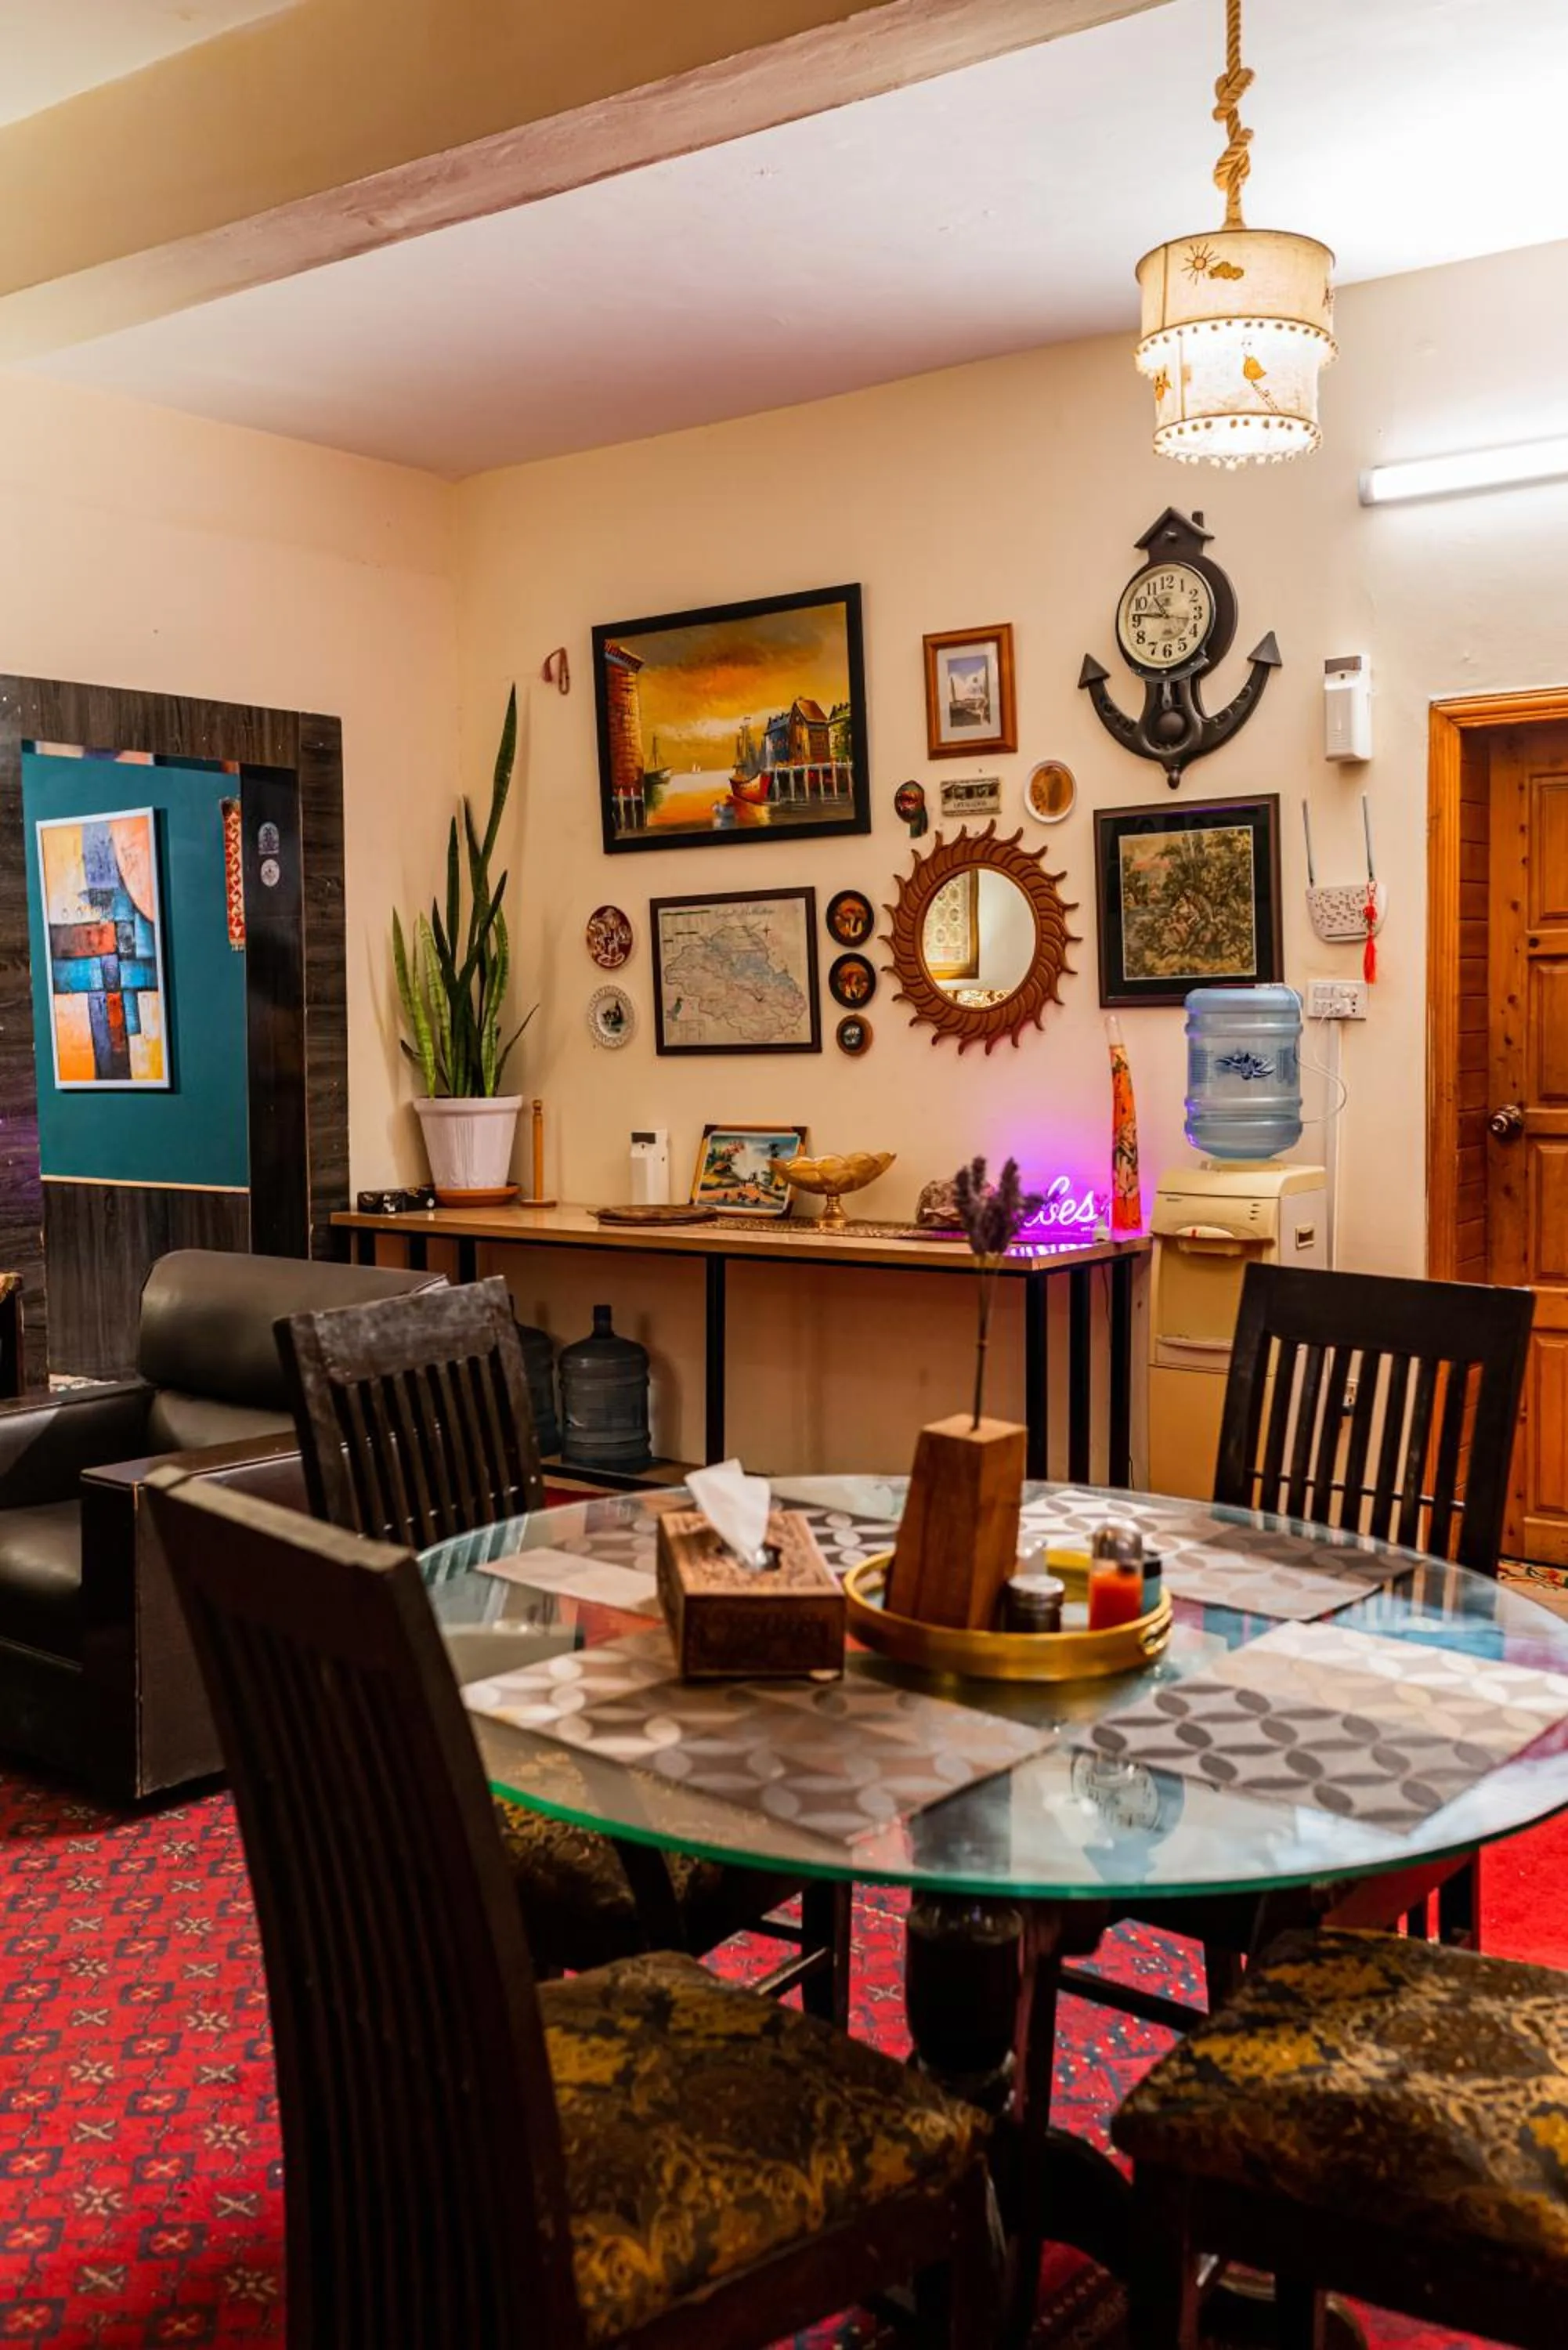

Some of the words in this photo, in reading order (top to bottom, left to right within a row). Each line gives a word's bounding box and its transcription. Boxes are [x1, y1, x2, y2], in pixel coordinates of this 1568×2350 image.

[1147, 582, 1158, 595] 11
[1160, 574, 1175, 589] 12
[1180, 579, 1185, 592] 1
[1189, 589, 1198, 602] 2
[1135, 597, 1147, 611] 10
[1132, 613, 1142, 627] 9
[1193, 606, 1202, 620] 3
[1136, 631, 1146, 645] 8
[1189, 624, 1198, 638] 4
[1147, 642, 1158, 656] 7
[1162, 643, 1172, 658] 6
[1178, 638, 1187, 652] 5
